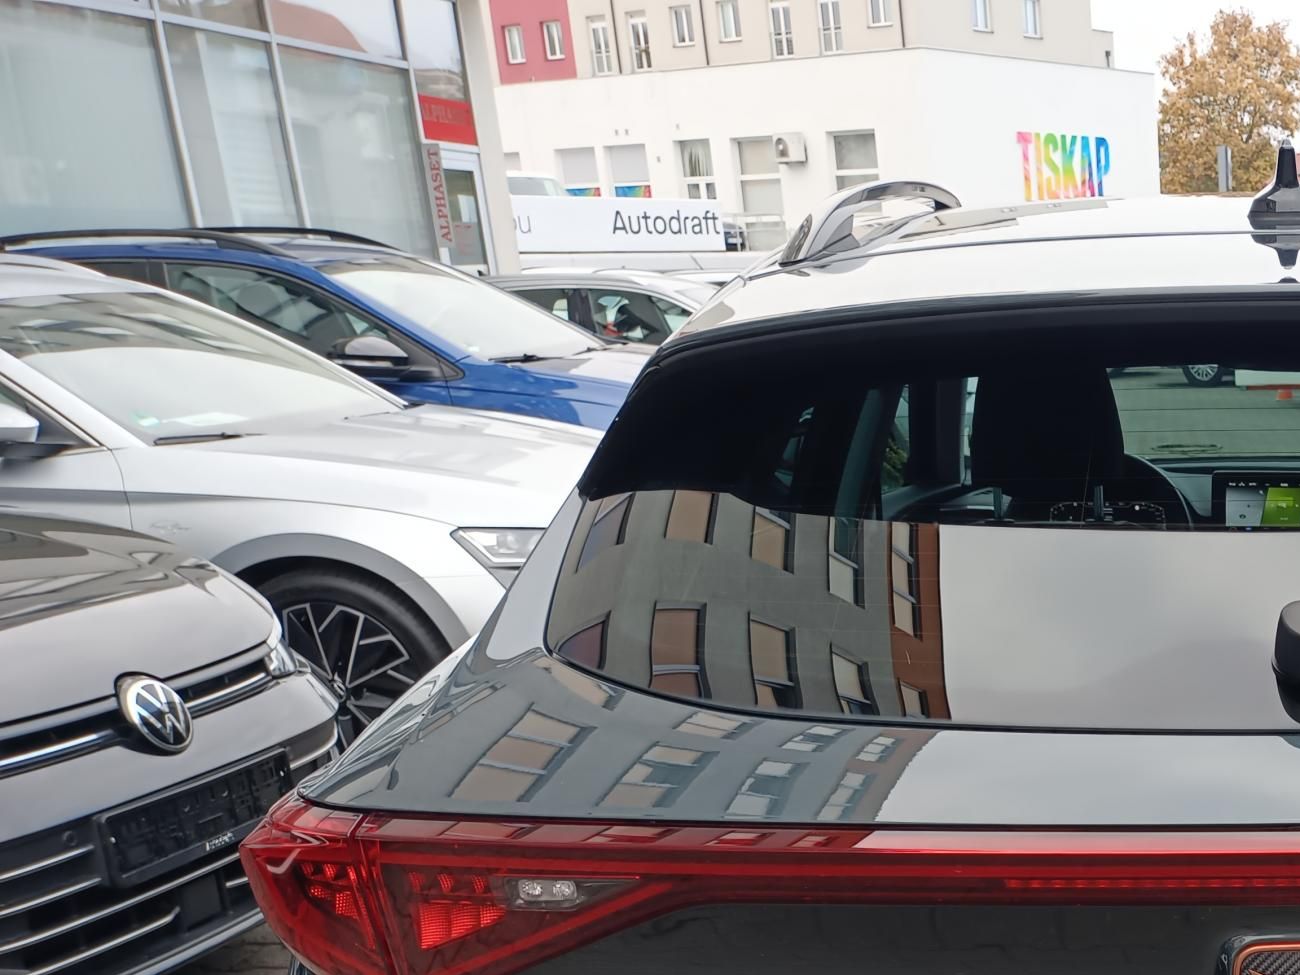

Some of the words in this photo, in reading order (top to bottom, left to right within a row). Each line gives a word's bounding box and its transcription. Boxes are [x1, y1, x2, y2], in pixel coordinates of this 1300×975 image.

[427, 147, 453, 242] ALPHASET
[1016, 131, 1111, 202] TISKAP
[612, 209, 721, 235] Autodraft
